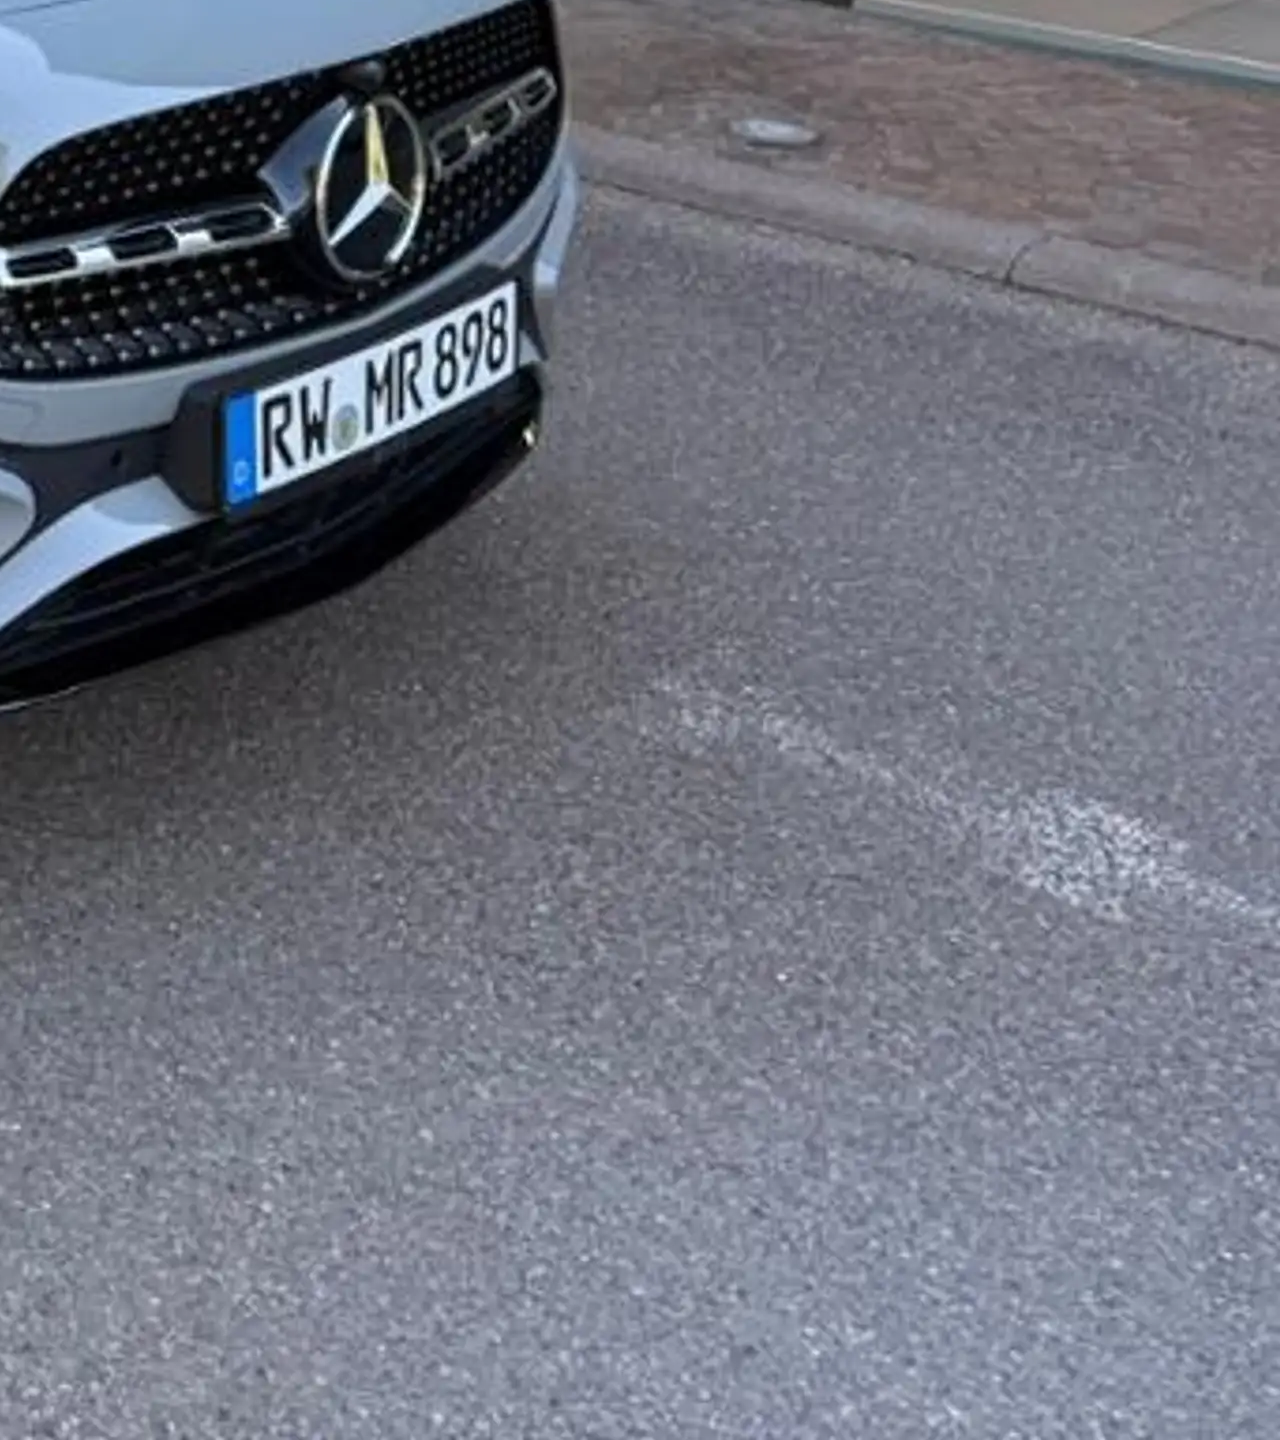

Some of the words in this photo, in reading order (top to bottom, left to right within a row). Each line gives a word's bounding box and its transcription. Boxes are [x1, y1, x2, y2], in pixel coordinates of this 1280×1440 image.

[262, 377, 333, 479] RW
[364, 340, 424, 436] MR
[433, 297, 509, 401] 898
